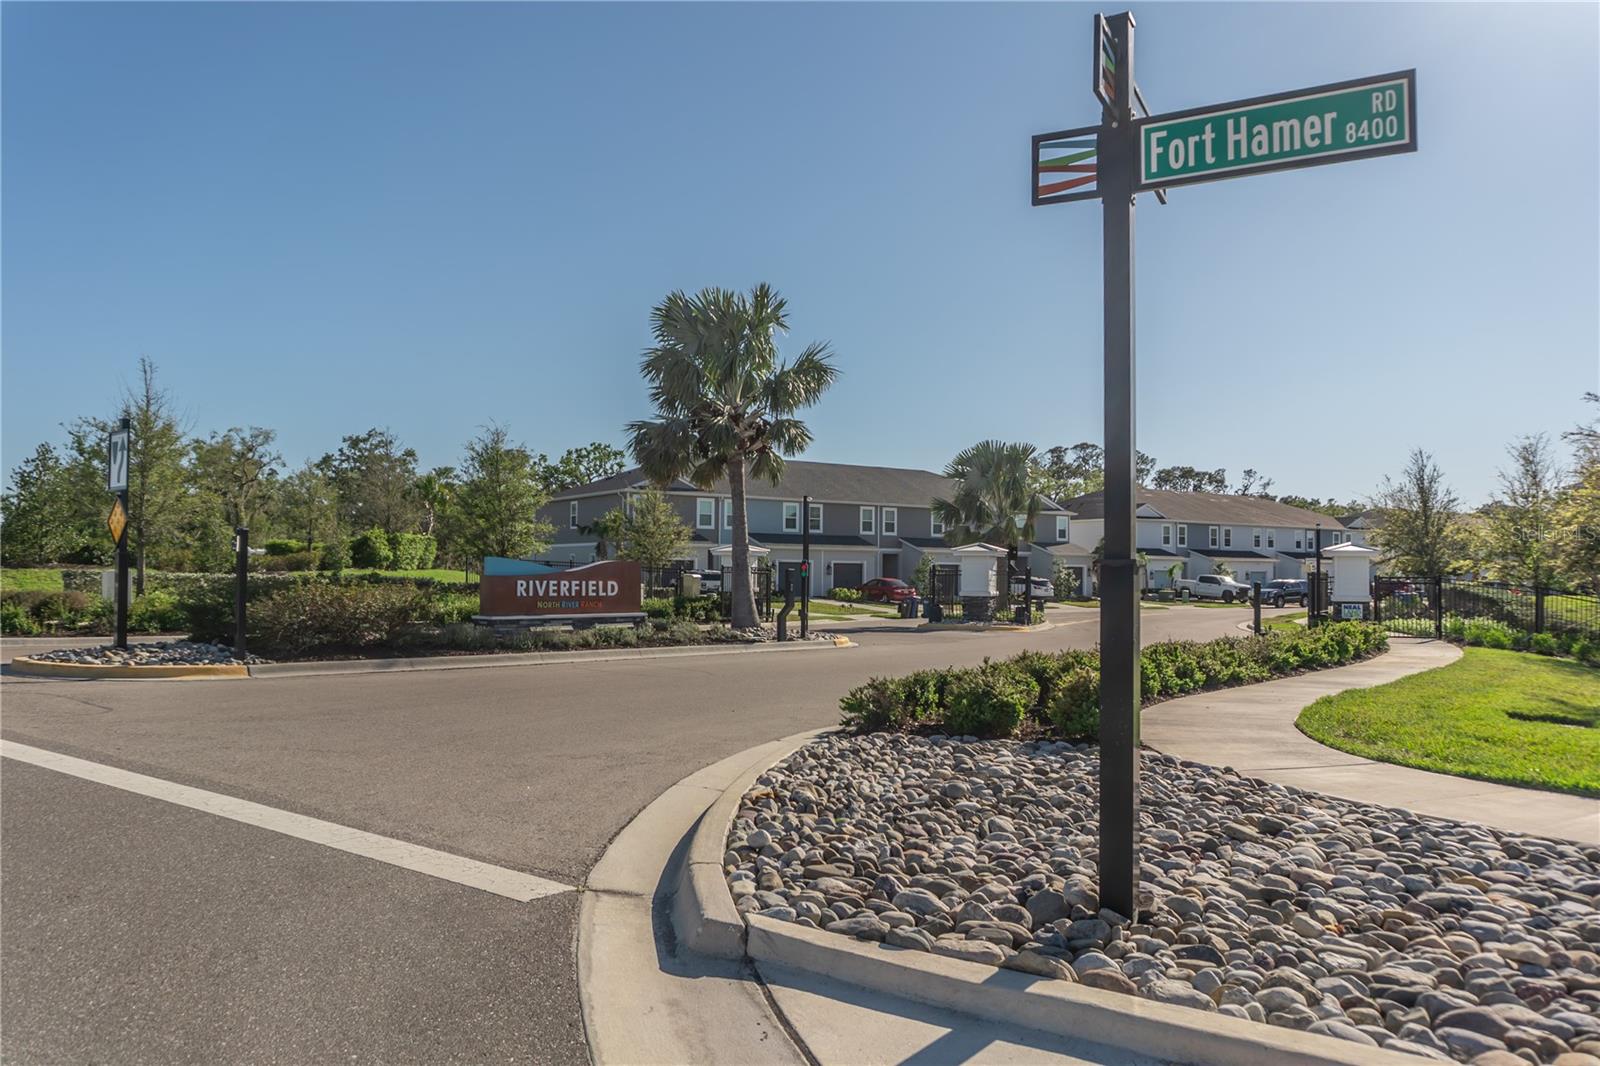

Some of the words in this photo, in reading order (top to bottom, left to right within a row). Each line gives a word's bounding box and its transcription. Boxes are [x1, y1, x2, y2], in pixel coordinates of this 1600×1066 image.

[1371, 89, 1397, 114] RD
[1149, 122, 1216, 173] Fort
[1226, 111, 1337, 160] Hamer
[1345, 115, 1398, 143] 8400
[516, 580, 619, 597] RIVERFIELD
[537, 600, 560, 609] NORTH
[561, 600, 579, 609] RIVER
[580, 600, 603, 609] RANCH
